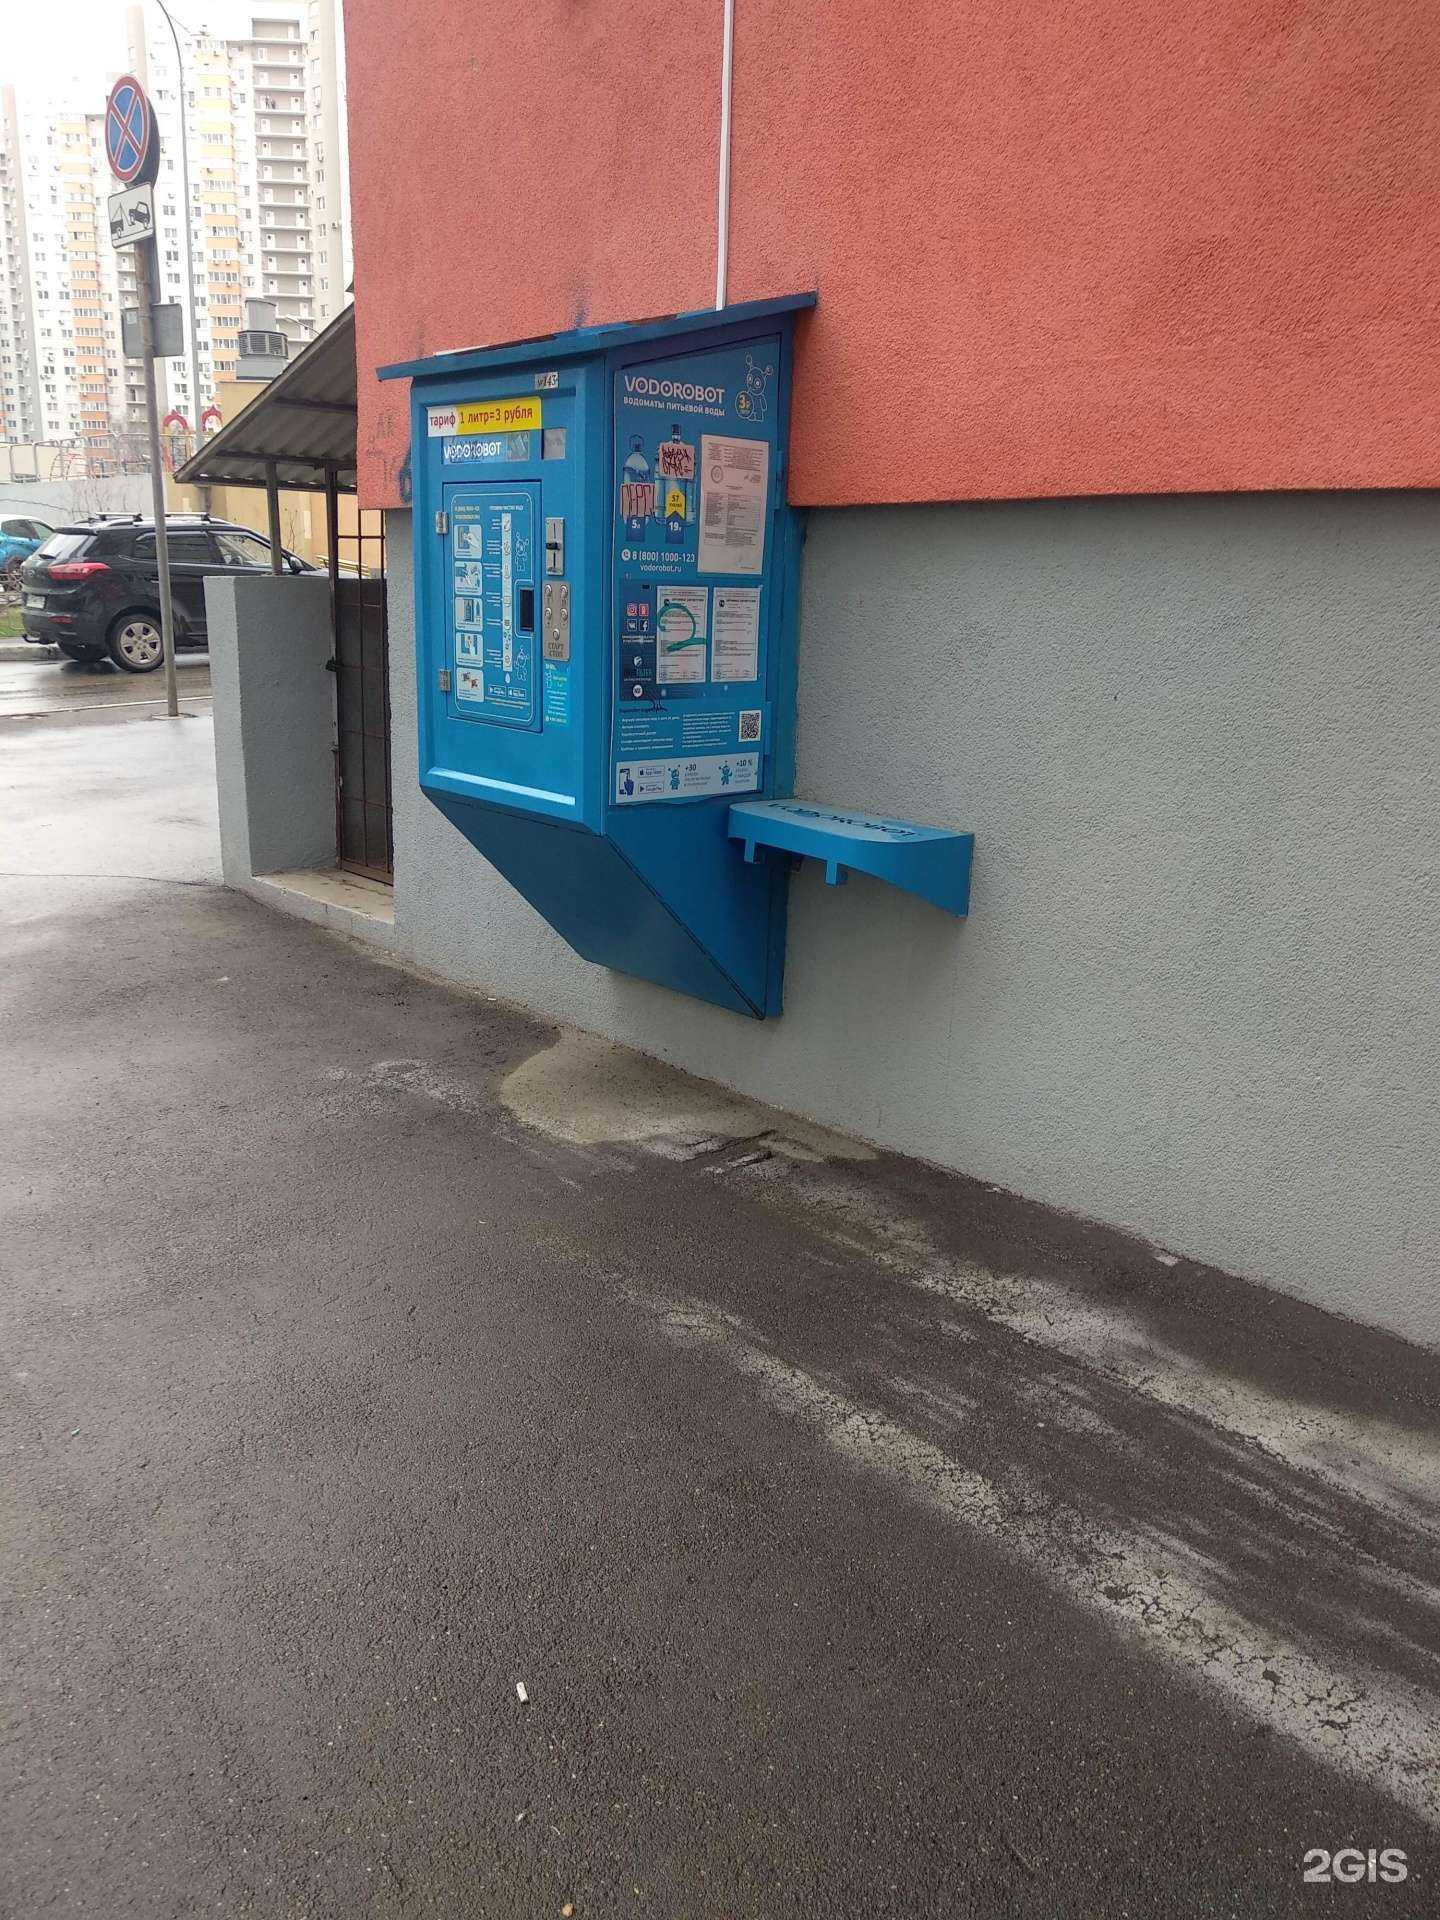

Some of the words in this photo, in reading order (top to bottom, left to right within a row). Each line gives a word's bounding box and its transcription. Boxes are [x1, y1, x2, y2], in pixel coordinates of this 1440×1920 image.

[624, 375, 725, 403] VODOROBOT
[623, 396, 665, 409] ВОДОМАТЫ
[666, 401, 704, 415] ПИТЬЕВОЙ
[704, 408, 726, 417] ВОДЫ
[429, 411, 456, 429] тариф
[460, 412, 465, 424] 1
[467, 408, 501, 425] литр=3
[504, 405, 533, 424] рубля
[638, 550, 659, 562] (800)
[661, 552, 695, 563] 1000-123
[640, 563, 682, 573] vodorobot.ru
[685, 763, 697, 772] +30
